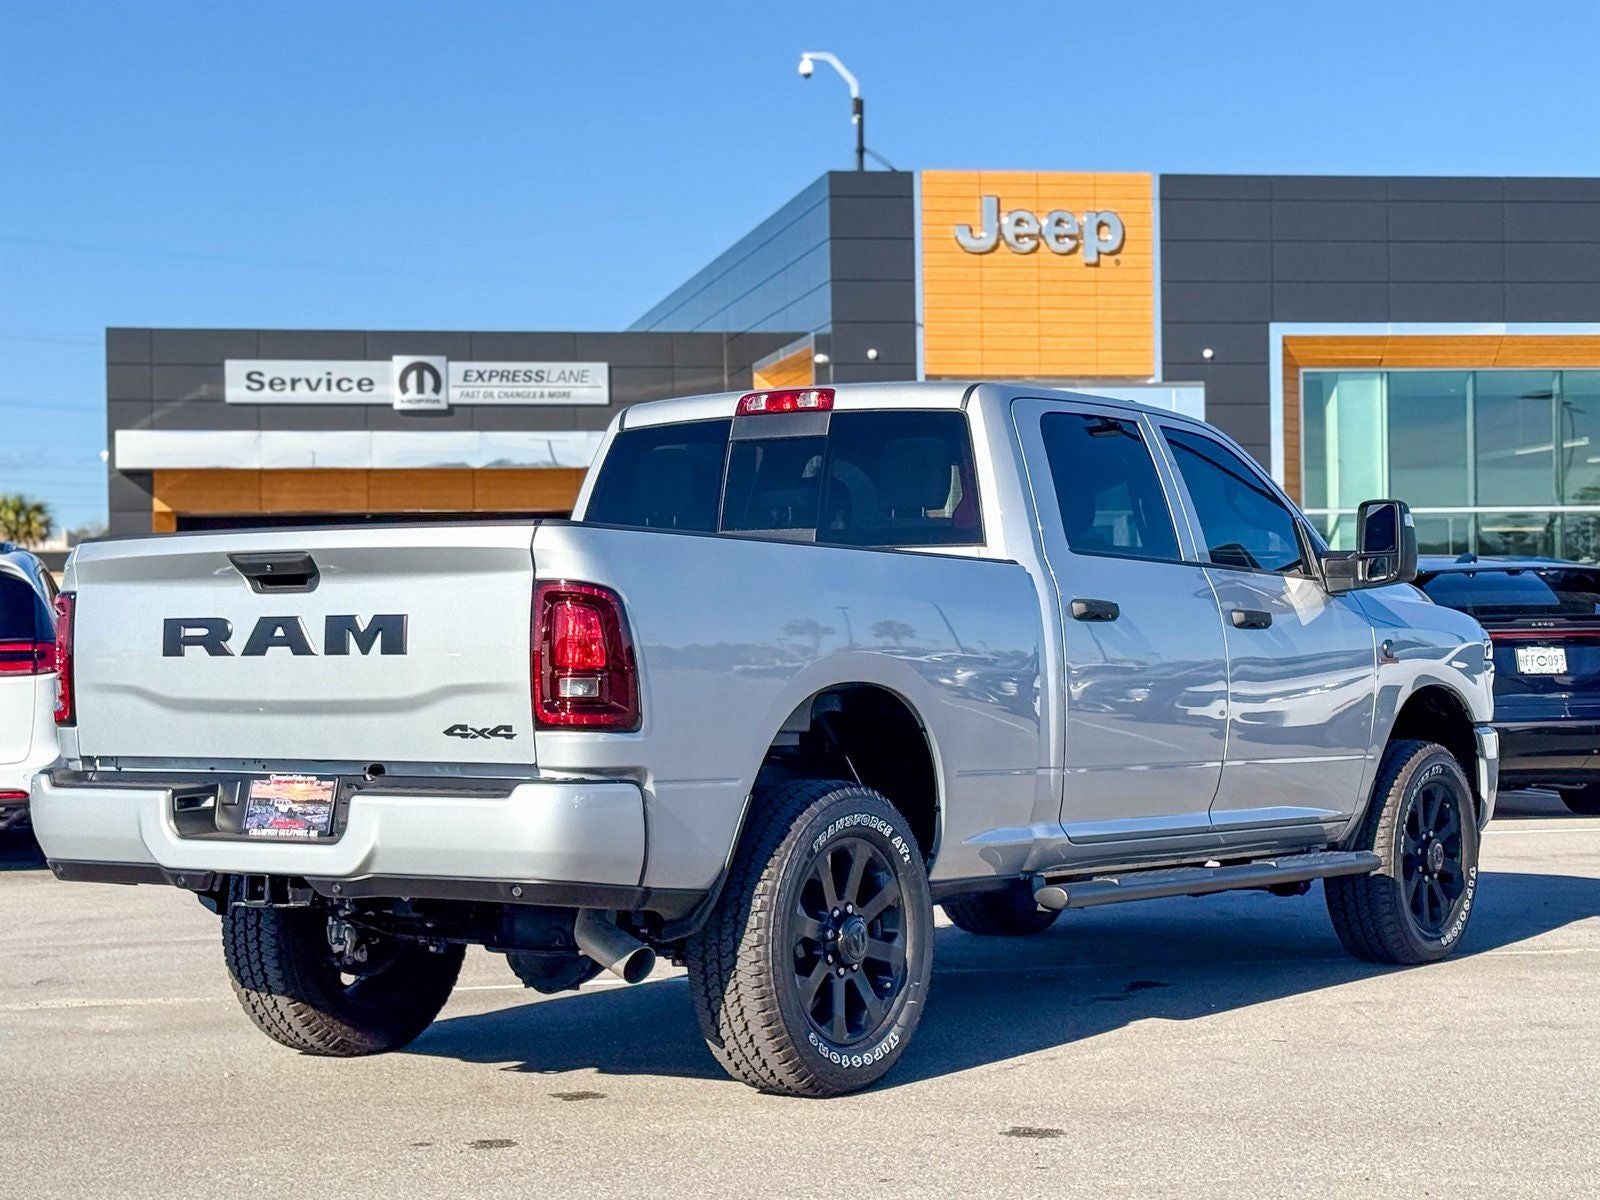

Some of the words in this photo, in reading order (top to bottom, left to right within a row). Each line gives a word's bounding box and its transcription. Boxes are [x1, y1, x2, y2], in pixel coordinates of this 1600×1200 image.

[955, 195, 1126, 266] Jeep
[245, 370, 375, 393] Service
[463, 369, 591, 384] EXPRESSLANE
[459, 390, 480, 399] FAST
[483, 390, 495, 399] OIL
[498, 390, 536, 400] CHANGES
[539, 391, 546, 400] &
[548, 391, 571, 400] MORE
[163, 614, 408, 657] RAM
[443, 724, 517, 739] 4x4
[813, 814, 894, 853] TRANSFORCE
[809, 1032, 900, 1068] Firestone
